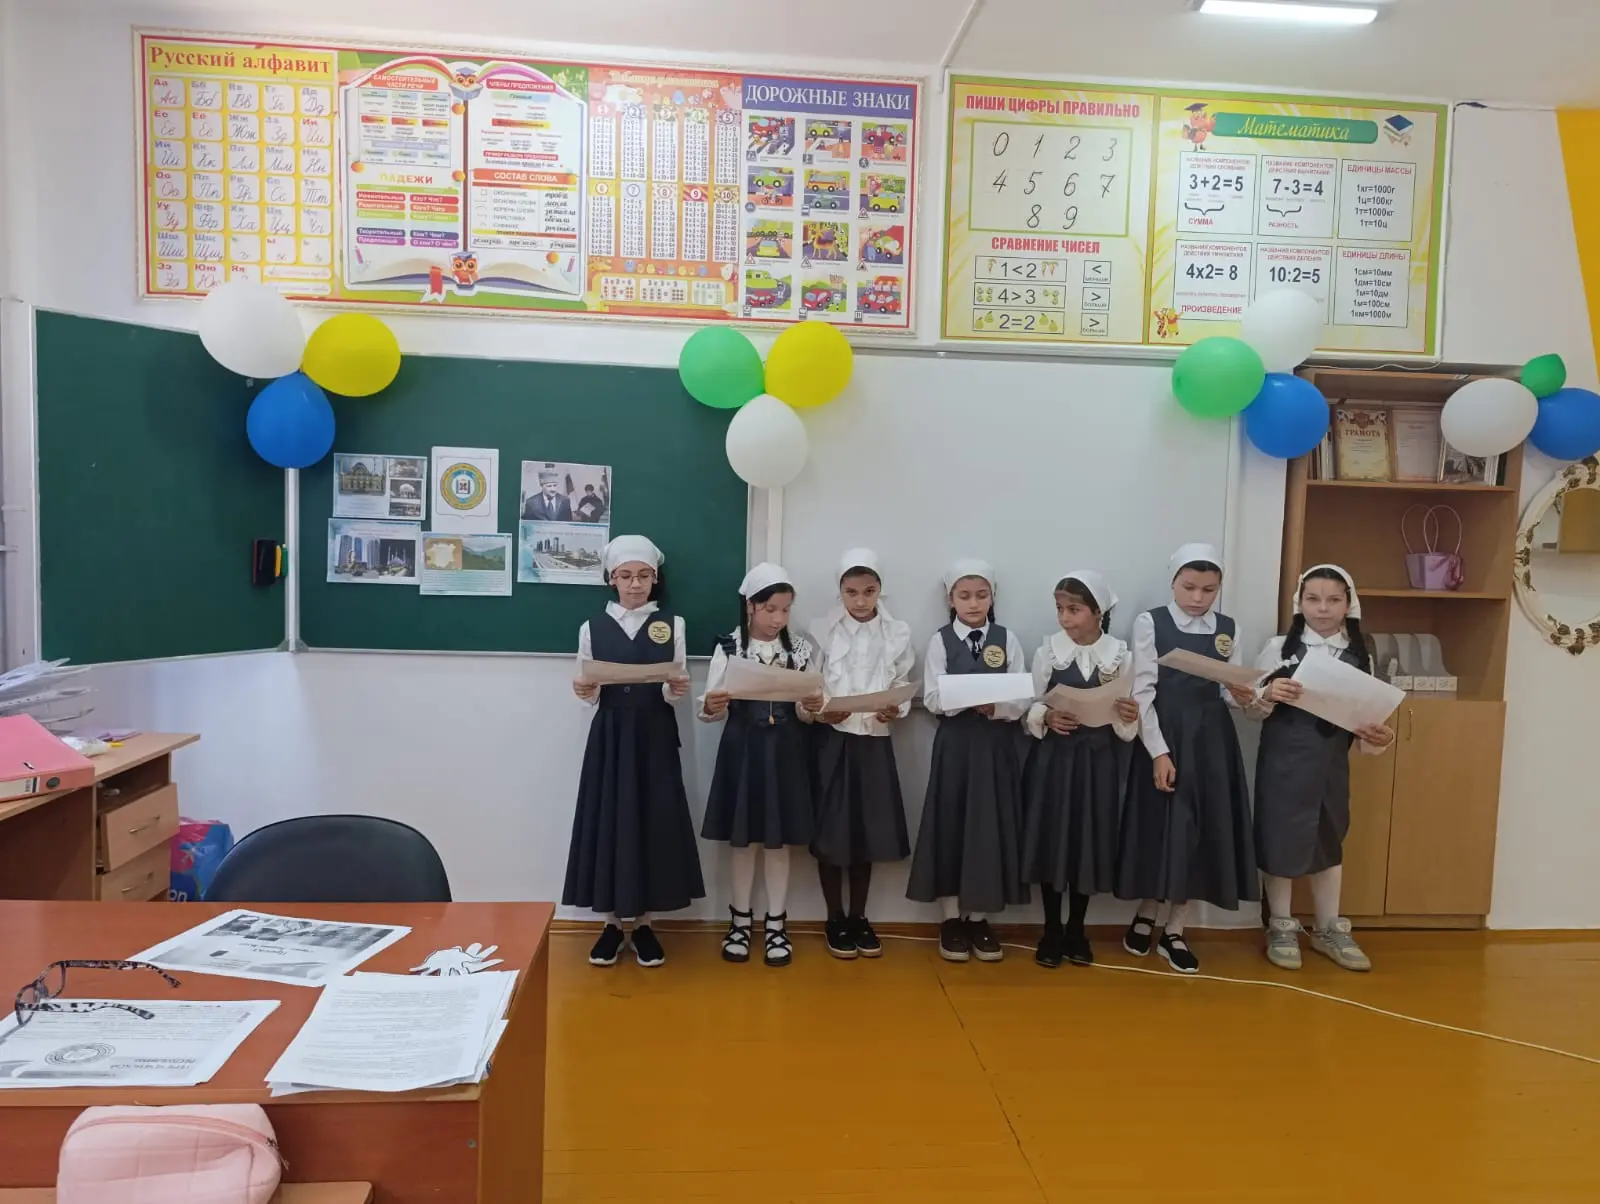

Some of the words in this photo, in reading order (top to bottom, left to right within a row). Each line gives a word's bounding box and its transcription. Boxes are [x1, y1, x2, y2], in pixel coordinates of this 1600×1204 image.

[151, 46, 235, 68] Русский
[243, 54, 331, 74] алфавит
[745, 85, 847, 107] ДОРОЖНЫЕ
[852, 91, 911, 111] ЗНАКИ
[966, 95, 1005, 110] ПИШИ
[1008, 98, 1060, 114] ЦИФРЫ
[1063, 101, 1140, 118] ПРАВИЛЬНО
[725, 114, 731, 122] 5
[1236, 116, 1350, 140] Математика
[993, 131, 1009, 156] 0
[1032, 134, 1044, 158] 1
[1063, 135, 1080, 160] 2
[1102, 138, 1117, 161] 3
[1347, 164, 1384, 174] ЕДИНИЦЫ
[1384, 166, 1412, 175] МАССЫ
[380, 173, 432, 184] ПАДЕЖИ
[494, 172, 527, 181] СОСТАВ
[529, 173, 557, 182] СЛОВА
[992, 169, 1007, 193] 4
[1023, 171, 1044, 195] 5
[1063, 172, 1079, 196] 6
[1099, 174, 1116, 198] 7
[662, 188, 668, 196] 8
[693, 190, 699, 198] 9
[723, 192, 731, 200] 10
[1357, 184, 1395, 194] 1кг=1000г
[1358, 196, 1393, 206] 1ц=100кг
[1026, 203, 1042, 228] 8
[1063, 205, 1078, 230] 9
[1355, 207, 1394, 217] 1т=1000кг
[1188, 218, 1213, 226] СУММА
[1268, 221, 1299, 229] РАЗНОСТЬ
[1360, 219, 1388, 229] 1т=10ц
[991, 237, 1058, 252] СРАВНЕНИЕ
[1062, 240, 1100, 254] ЧИСЕЛ
[1343, 250, 1377, 259] ЕДИНИЦЫ
[1379, 252, 1406, 261] ДЛИНЫ
[1269, 266, 1320, 283] 10:2=5
[1355, 267, 1392, 277] 1см=10мм
[1354, 278, 1392, 288] 1дм=10см
[1356, 289, 1389, 298] 1м=10дм
[1353, 299, 1390, 308] 1м=100см
[1181, 304, 1243, 314] ПРОИЗВЕДЕНИЕ
[1351, 309, 1391, 319] 1км=1000м
[1344, 429, 1381, 437] ГРАМОТА
